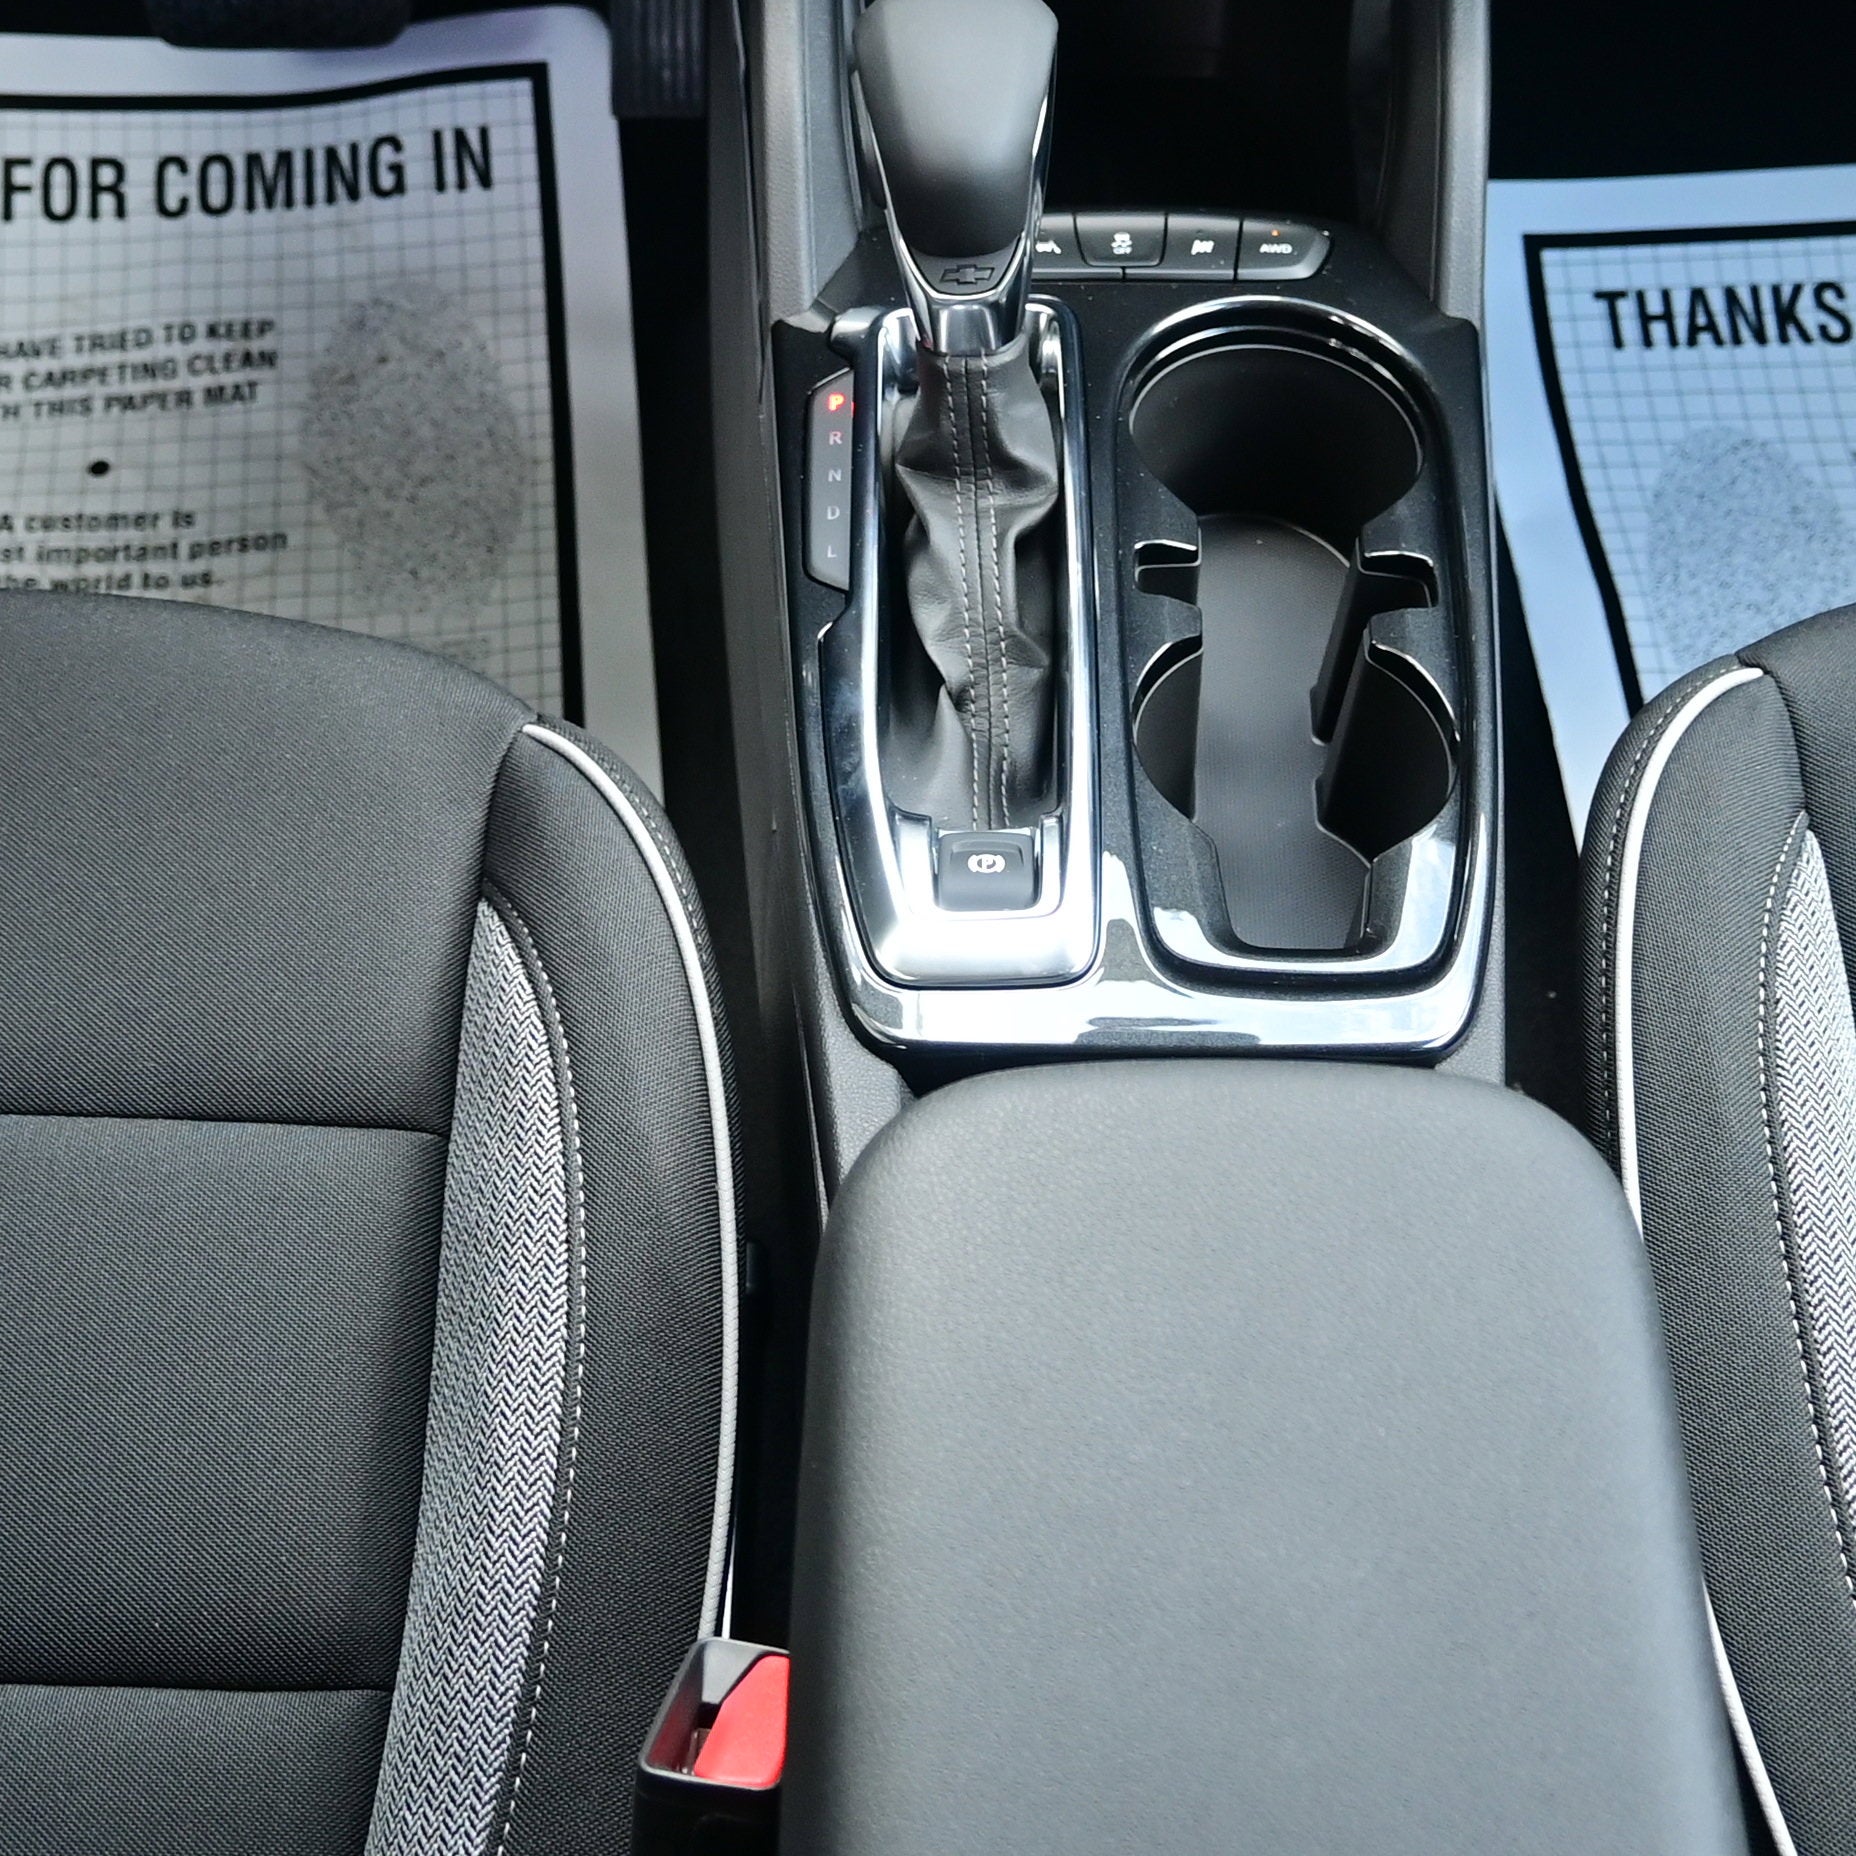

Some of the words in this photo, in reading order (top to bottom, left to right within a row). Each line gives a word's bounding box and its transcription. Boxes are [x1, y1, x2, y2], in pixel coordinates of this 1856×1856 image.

[2, 156, 128, 223] FOR
[155, 134, 407, 219] COMING
[432, 125, 494, 193] IN
[1259, 243, 1293, 254] AWD
[1594, 280, 1853, 350] THANKS
[74, 326, 153, 353] TRIED
[163, 323, 196, 346] TO
[205, 318, 275, 342] KEEP
[23, 358, 179, 393] CARPETING
[187, 349, 278, 378] CLEAN
[33, 395, 93, 419] THIS
[104, 389, 194, 413] PAPER
[204, 380, 259, 408] MAT
[828, 393, 845, 412] P
[829, 430, 843, 445] R
[828, 469, 842, 482] N
[24, 512, 160, 533] customer
[171, 510, 196, 529] is
[826, 505, 841, 520] D
[35, 537, 180, 567] important
[188, 532, 288, 563] person
[827, 546, 837, 558] L
[142, 571, 170, 591] to
